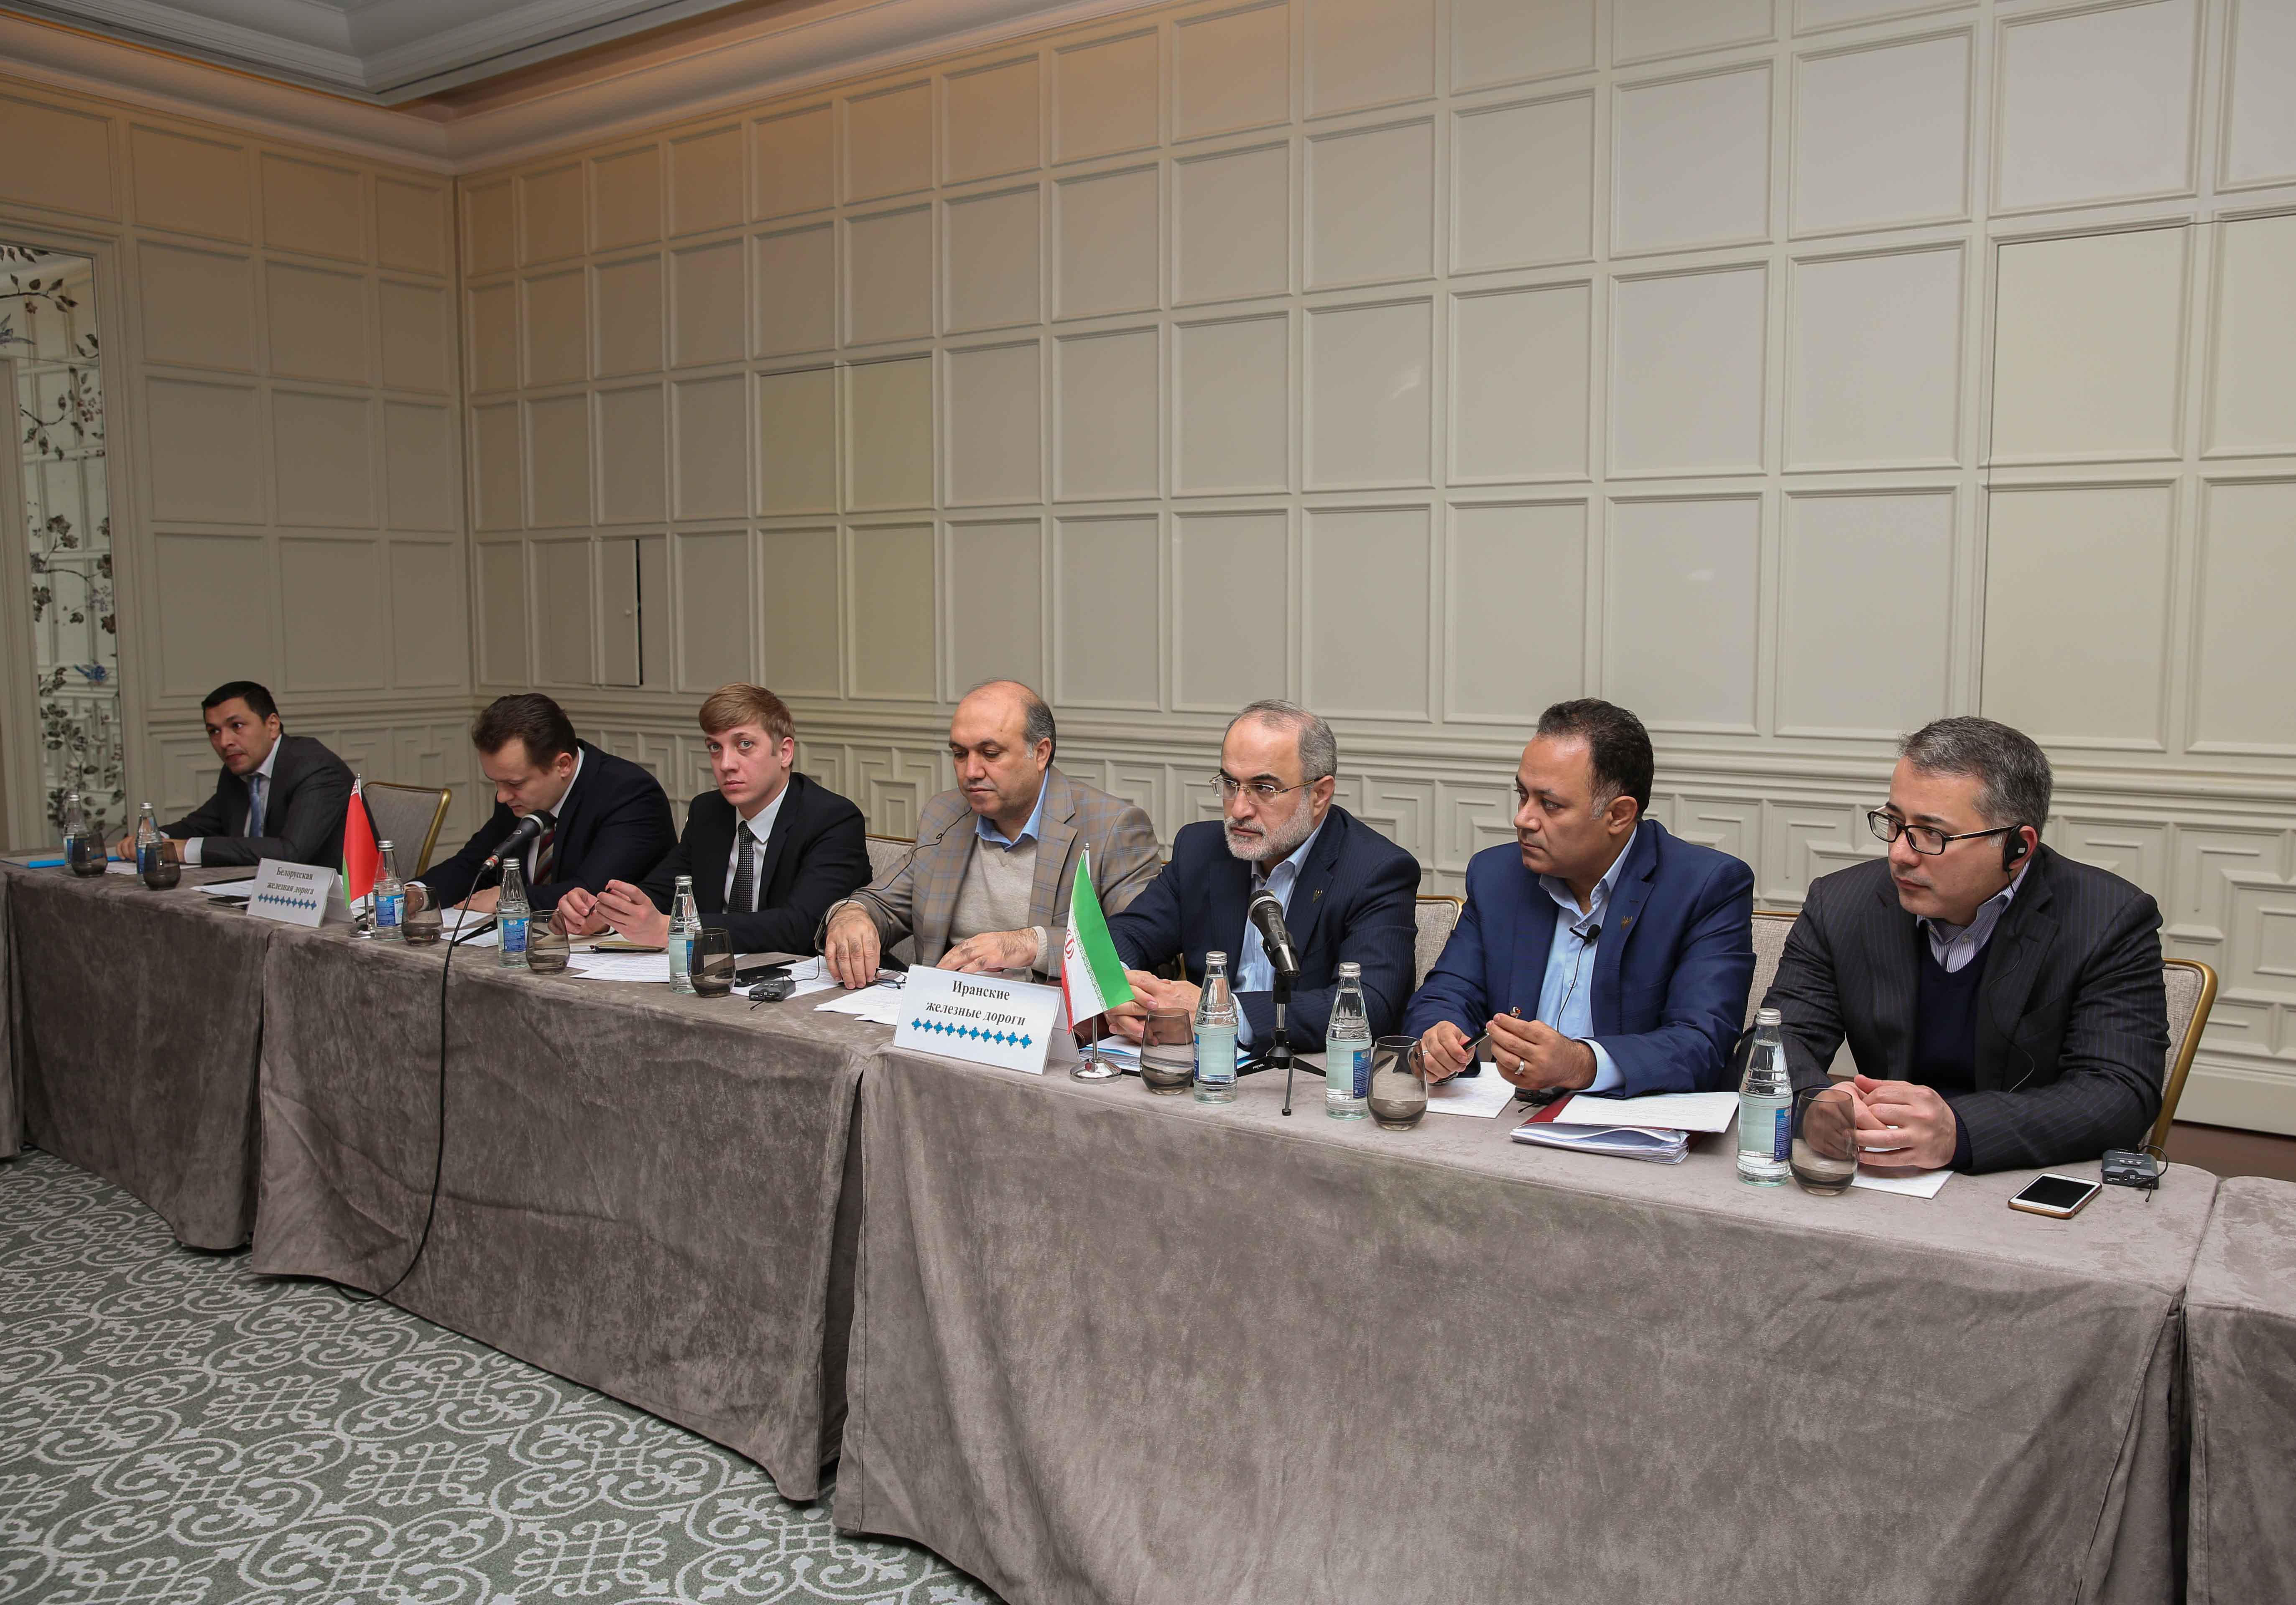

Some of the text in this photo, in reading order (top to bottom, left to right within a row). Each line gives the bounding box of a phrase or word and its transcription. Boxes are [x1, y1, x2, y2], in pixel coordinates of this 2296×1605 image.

[276, 867, 313, 880] Белорусская
[267, 882, 314, 895] железная дорога
[952, 980, 1010, 1000] Иранские
[926, 1002, 1026, 1026] железные дороги
